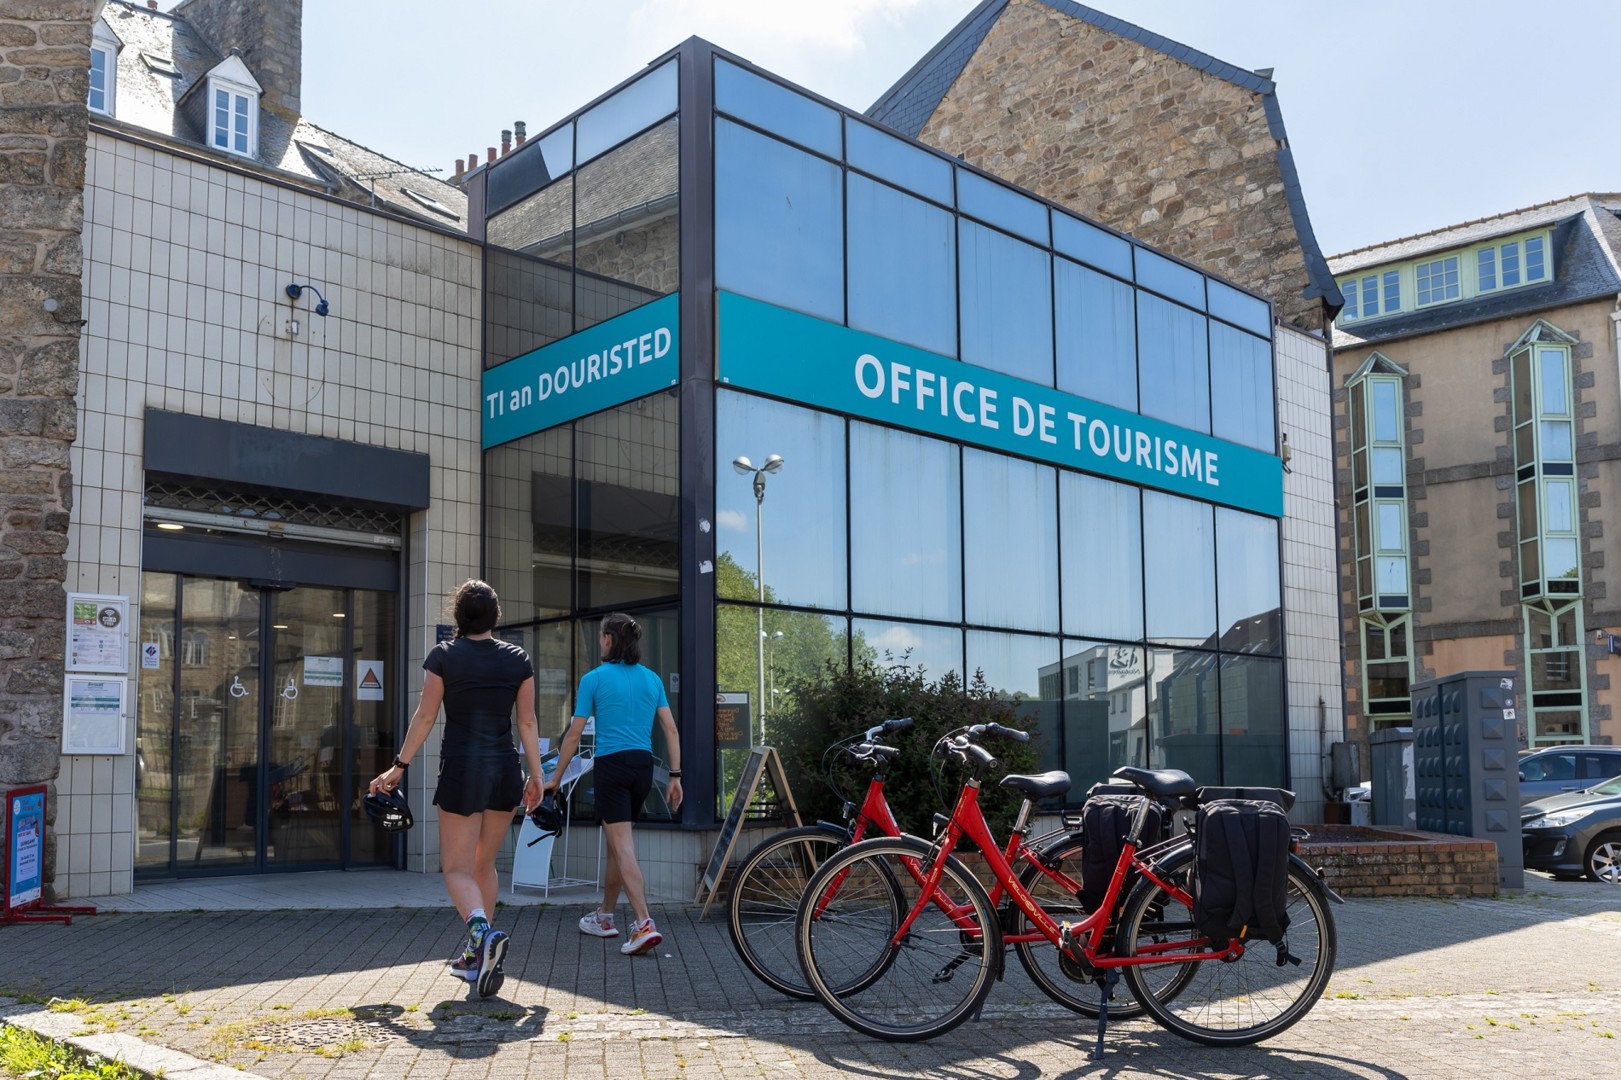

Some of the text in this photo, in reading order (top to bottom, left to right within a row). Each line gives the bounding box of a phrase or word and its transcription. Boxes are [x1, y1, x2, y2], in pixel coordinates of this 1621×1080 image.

[486, 327, 671, 419] TI an DOURISTED
[855, 353, 1219, 487] OFFICE DE TOURISME
[1008, 875, 1057, 934] VELO VILLE
